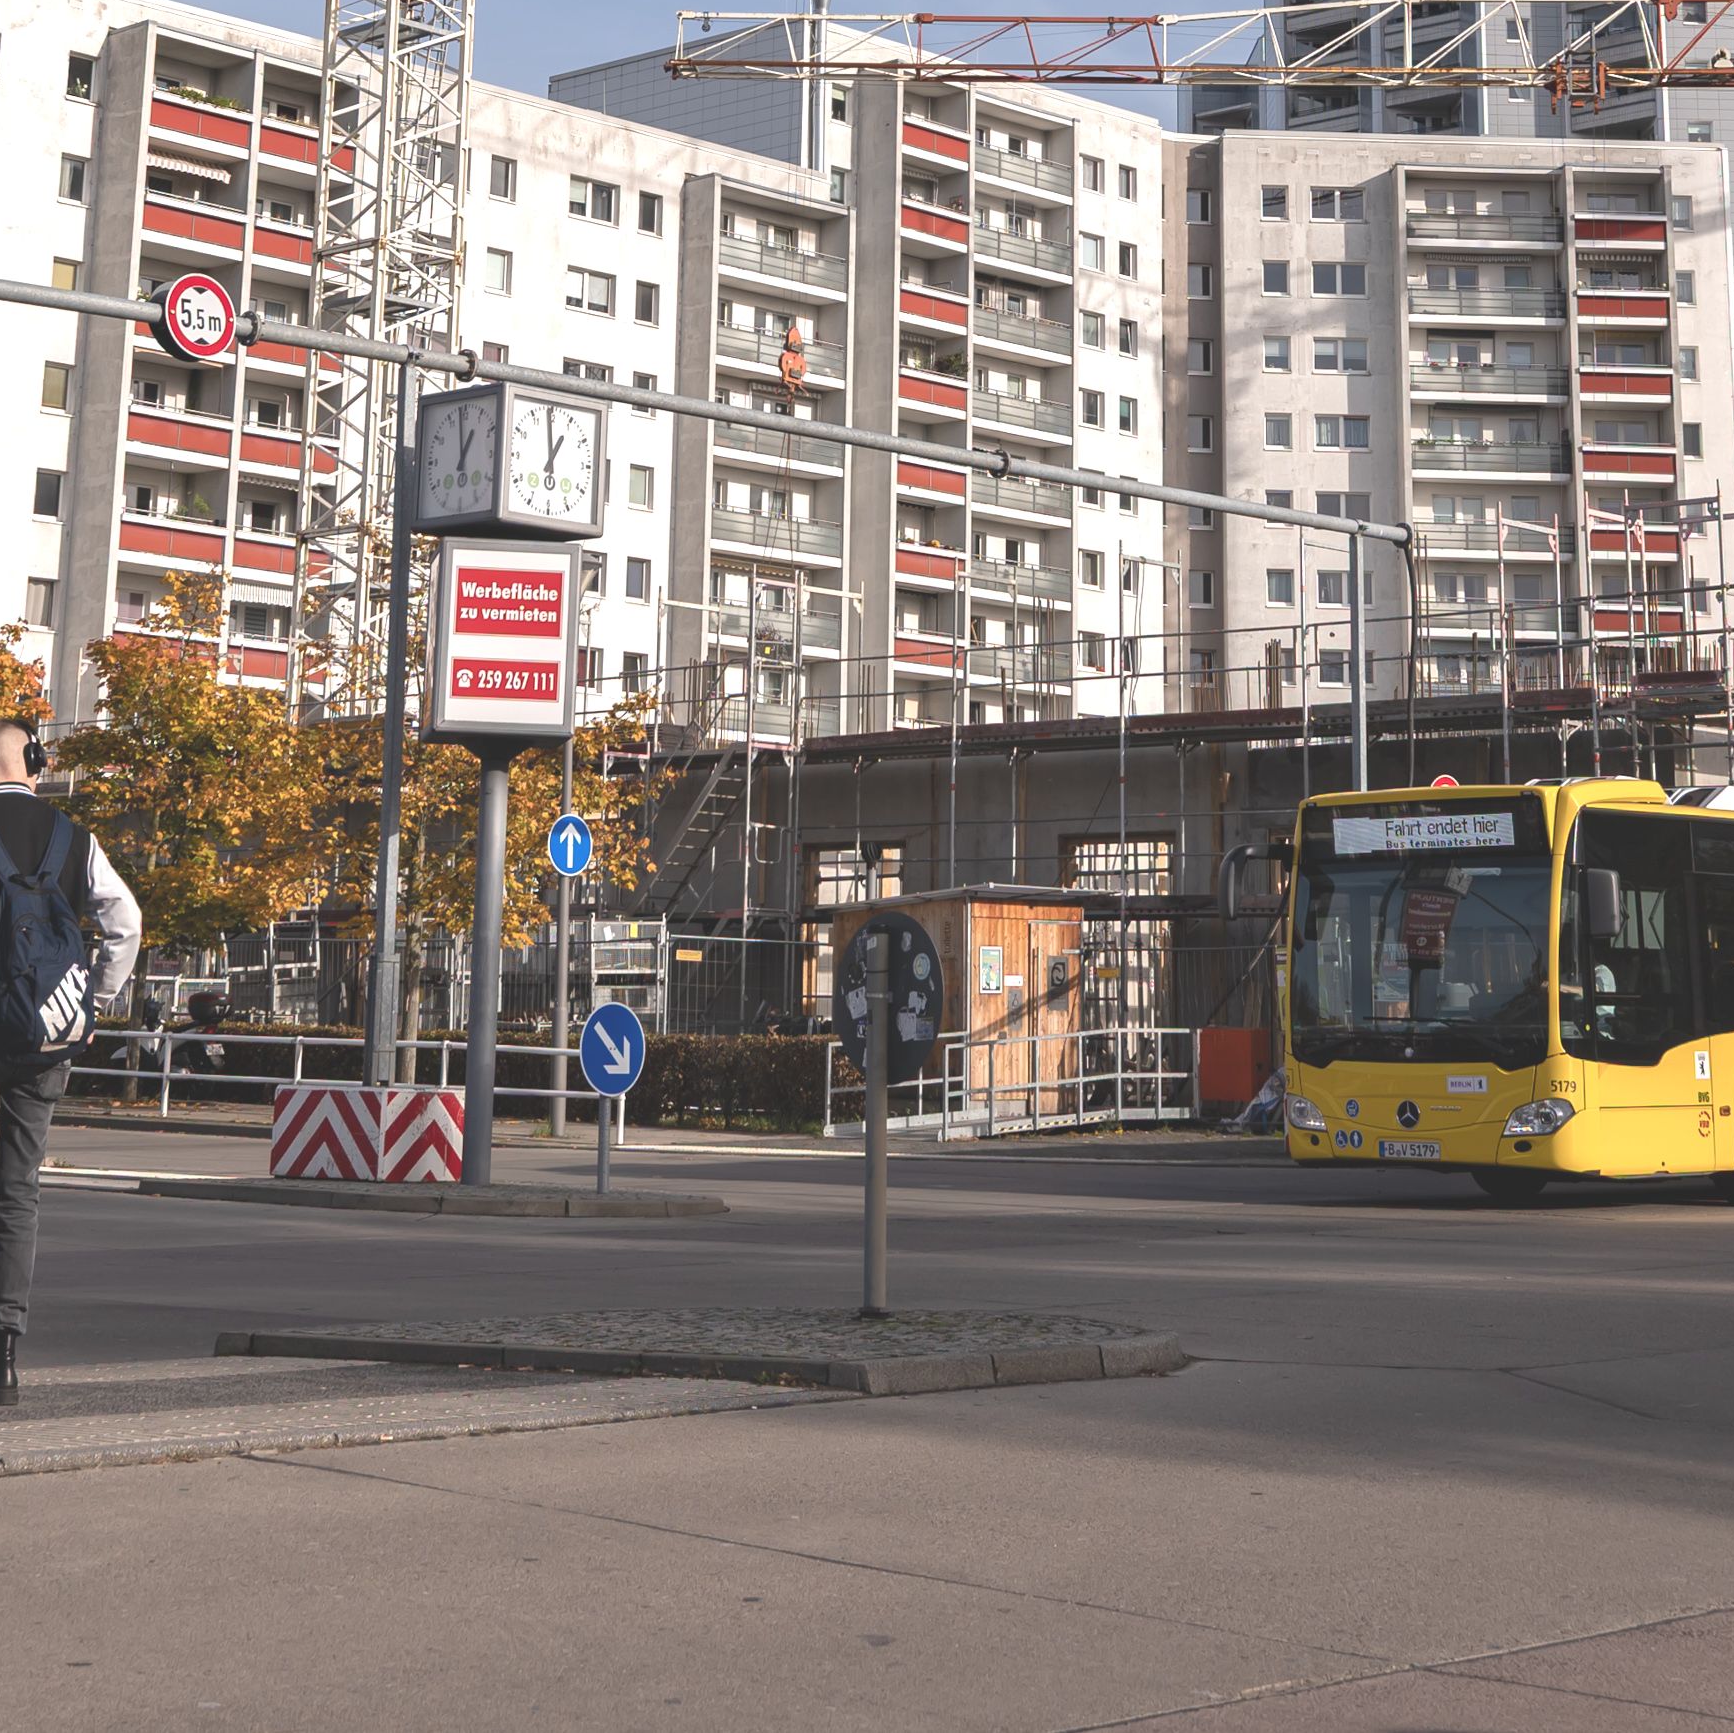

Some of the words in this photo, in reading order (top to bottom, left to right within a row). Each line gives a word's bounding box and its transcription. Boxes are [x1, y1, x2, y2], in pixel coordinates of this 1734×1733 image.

[181, 298, 205, 331] 5,5
[209, 315, 222, 332] m
[461, 581, 559, 602] Werbefläche
[460, 607, 478, 619] zu
[482, 604, 557, 623] vermieten
[477, 669, 502, 689] 259
[505, 670, 529, 690] 267
[533, 672, 554, 691] 111
[1385, 820, 1422, 837] Fahrt
[1427, 818, 1468, 836] endet
[1473, 816, 1499, 834] hier
[1386, 840, 1406, 849] Bus
[1410, 837, 1472, 848] terminates
[1475, 836, 1502, 846] here
[1450, 1080, 1472, 1089] BERLIN
[1550, 1080, 1577, 1093] 5179
[1388, 1144, 1396, 1156] B
[1400, 1144, 1409, 1157] V
[1410, 1144, 1436, 1158] 5179
